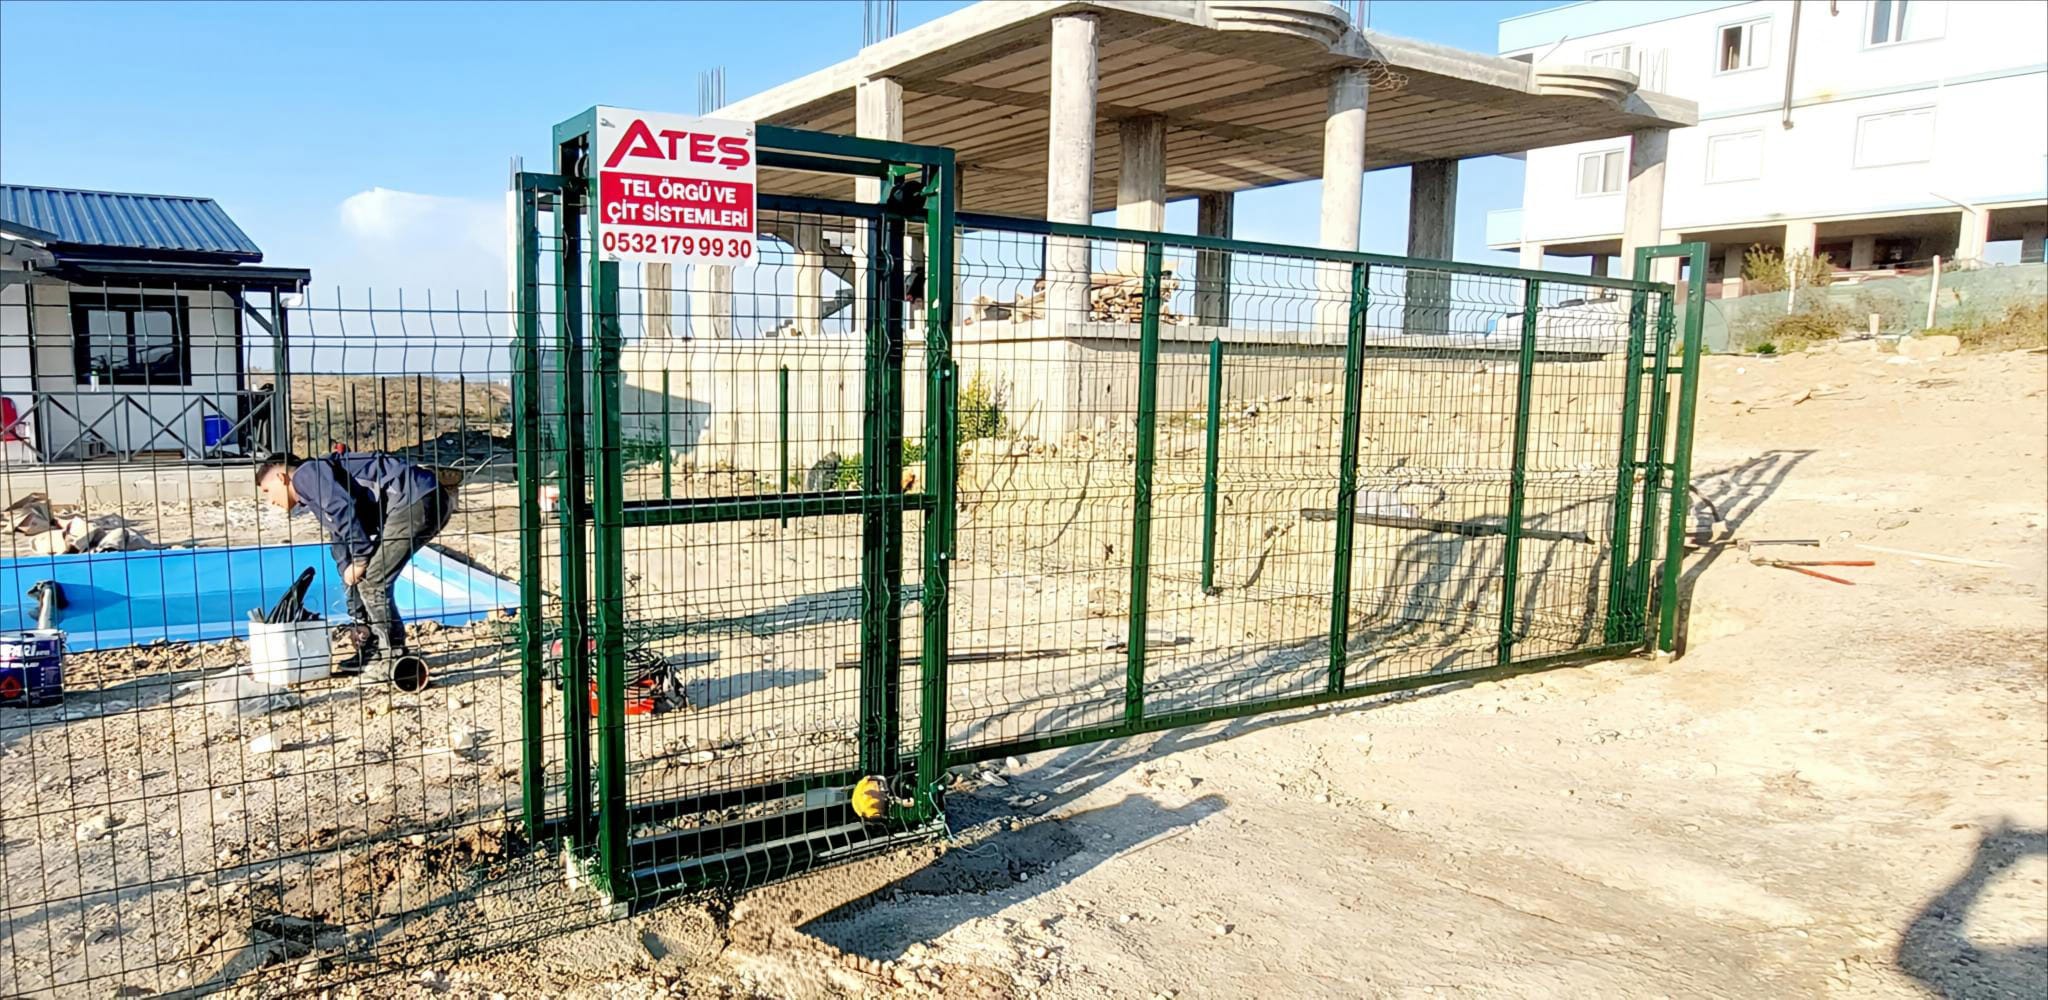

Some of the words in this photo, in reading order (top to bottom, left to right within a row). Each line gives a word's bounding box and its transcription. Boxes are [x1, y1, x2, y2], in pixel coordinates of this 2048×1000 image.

[603, 119, 750, 170] ATEŞ
[620, 178, 655, 198] TEL
[658, 178, 711, 201] ÖRGÜ
[714, 187, 736, 203] VE
[607, 199, 639, 223] ÇİT
[642, 201, 748, 227] SİSTEMLERİ
[603, 231, 657, 253] 0532
[661, 235, 694, 255] 179
[699, 237, 723, 256] 99
[728, 239, 752, 258] 30
